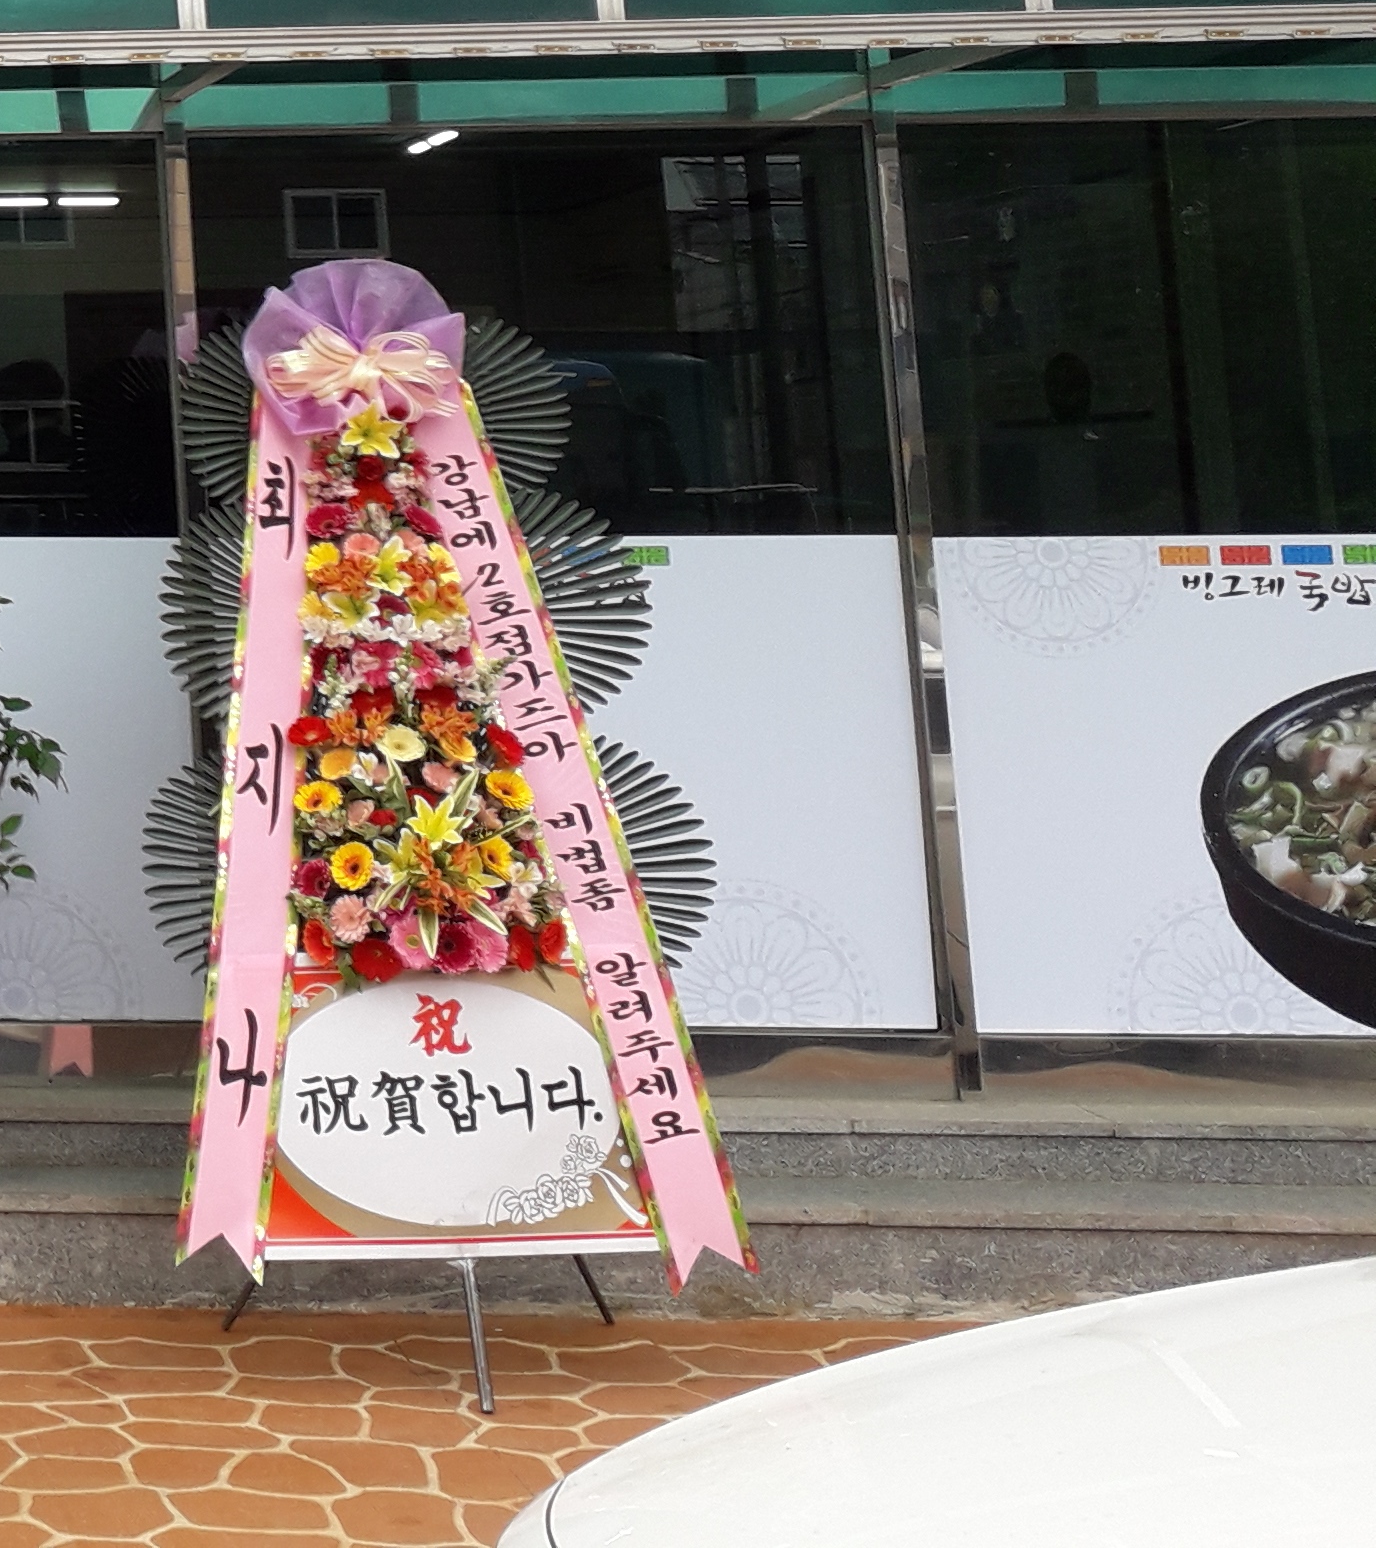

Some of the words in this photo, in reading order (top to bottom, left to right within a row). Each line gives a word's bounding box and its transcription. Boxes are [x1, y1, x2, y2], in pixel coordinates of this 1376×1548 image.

[1182, 572, 1285, 601] 빙그레
[1294, 570, 1376, 612] 국밥
[430, 455, 497, 550] 강남에
[595, 952, 701, 1145] 알려주세요
[410, 993, 472, 1056] 祝
